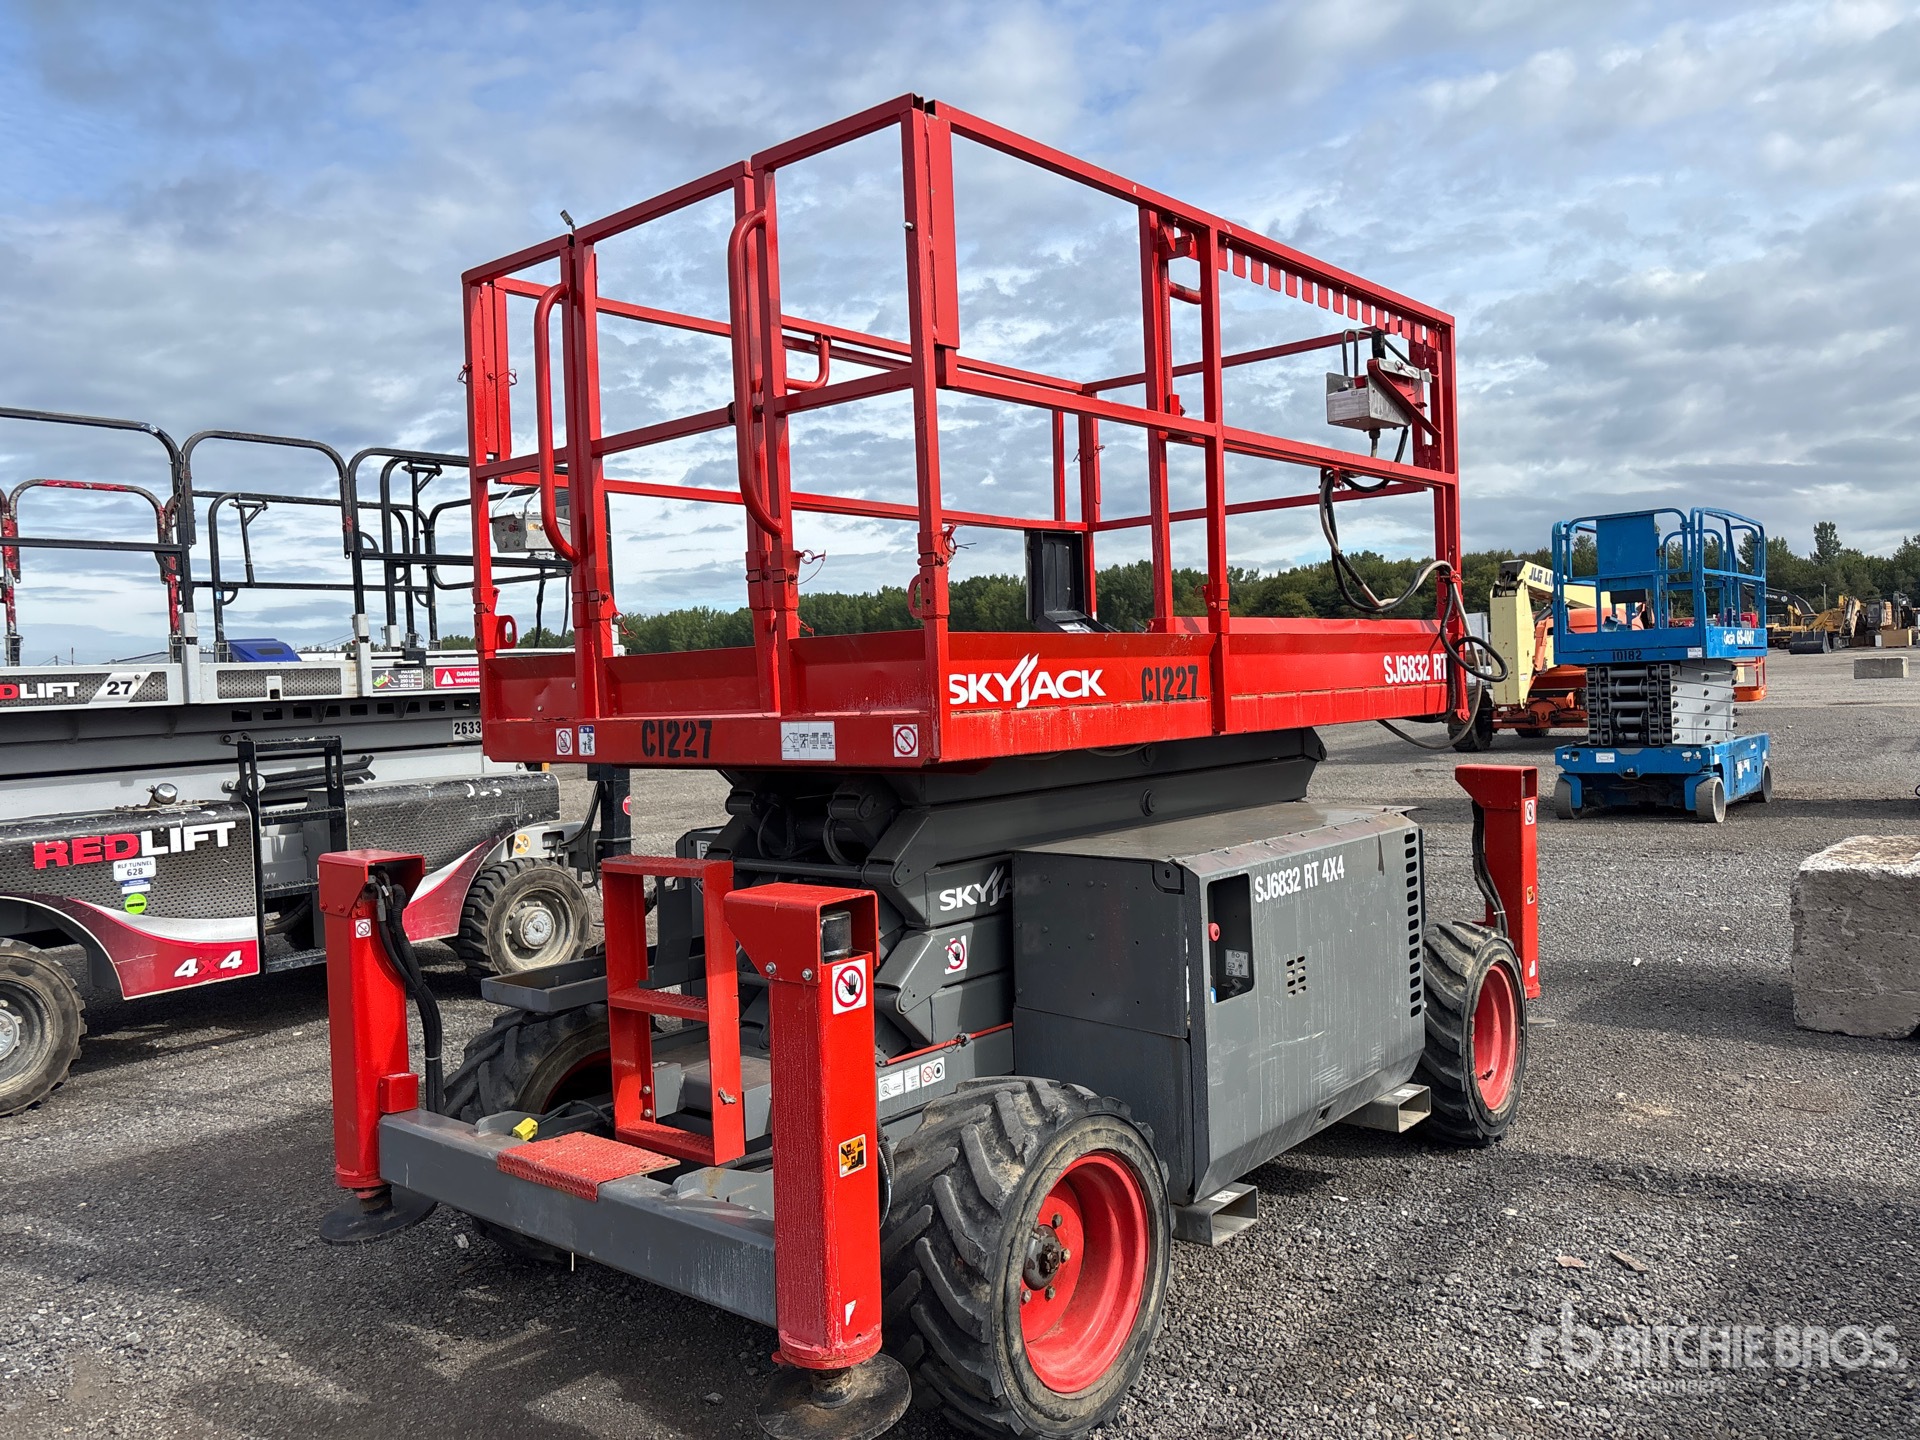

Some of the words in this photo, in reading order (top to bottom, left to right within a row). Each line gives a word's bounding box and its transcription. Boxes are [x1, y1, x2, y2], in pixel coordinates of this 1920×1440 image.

[1529, 567, 1543, 583] JLG
[1383, 654, 1431, 684] SJ6832
[1433, 653, 1448, 680] RT
[107, 681, 132, 696] 27
[949, 653, 1107, 709] SKYJACK
[454, 721, 482, 735] 2633
[33, 821, 236, 870] REDLIFT
[126, 868, 144, 876] 628
[1254, 867, 1302, 903] SJ6832
[1303, 861, 1319, 889] RT
[1322, 854, 1345, 883] 4X4
